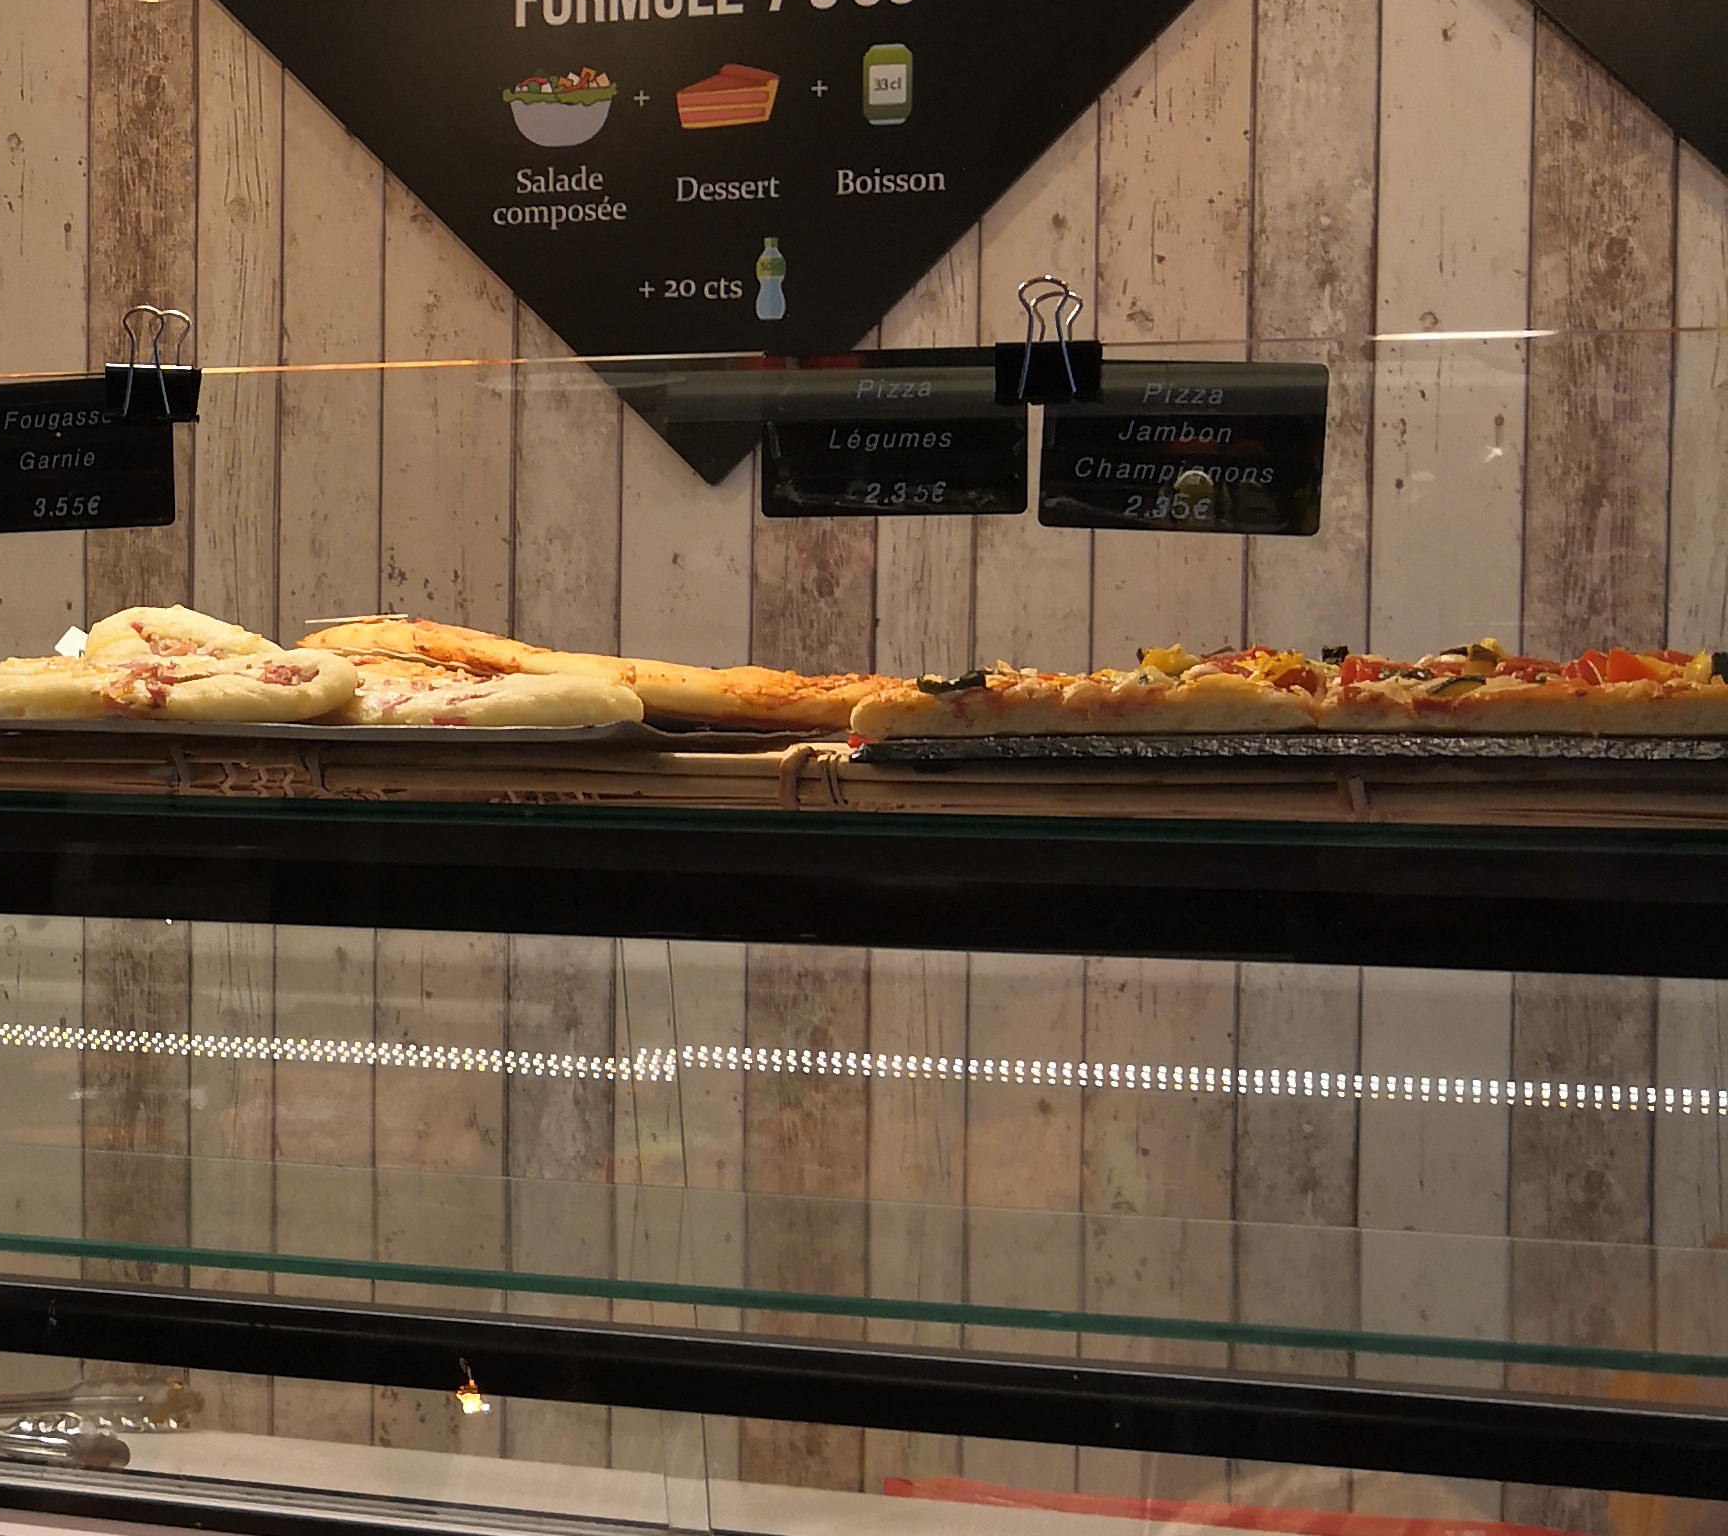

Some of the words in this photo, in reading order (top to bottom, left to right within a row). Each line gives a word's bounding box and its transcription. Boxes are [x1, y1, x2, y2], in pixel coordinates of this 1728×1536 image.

[515, 166, 604, 195] Salade
[676, 175, 780, 202] Dessert
[836, 168, 946, 196] Boisson
[492, 195, 627, 230] composée
[663, 278, 697, 299] 20
[704, 275, 744, 299] cts
[856, 379, 933, 400] Pizza
[1142, 382, 1225, 405] Pizza
[829, 427, 953, 452] Légumes
[1118, 419, 1232, 443] Jambon
[19, 448, 95, 471] Garnie
[864, 480, 947, 505] 2.35€
[33, 495, 101, 518] 3.55€
